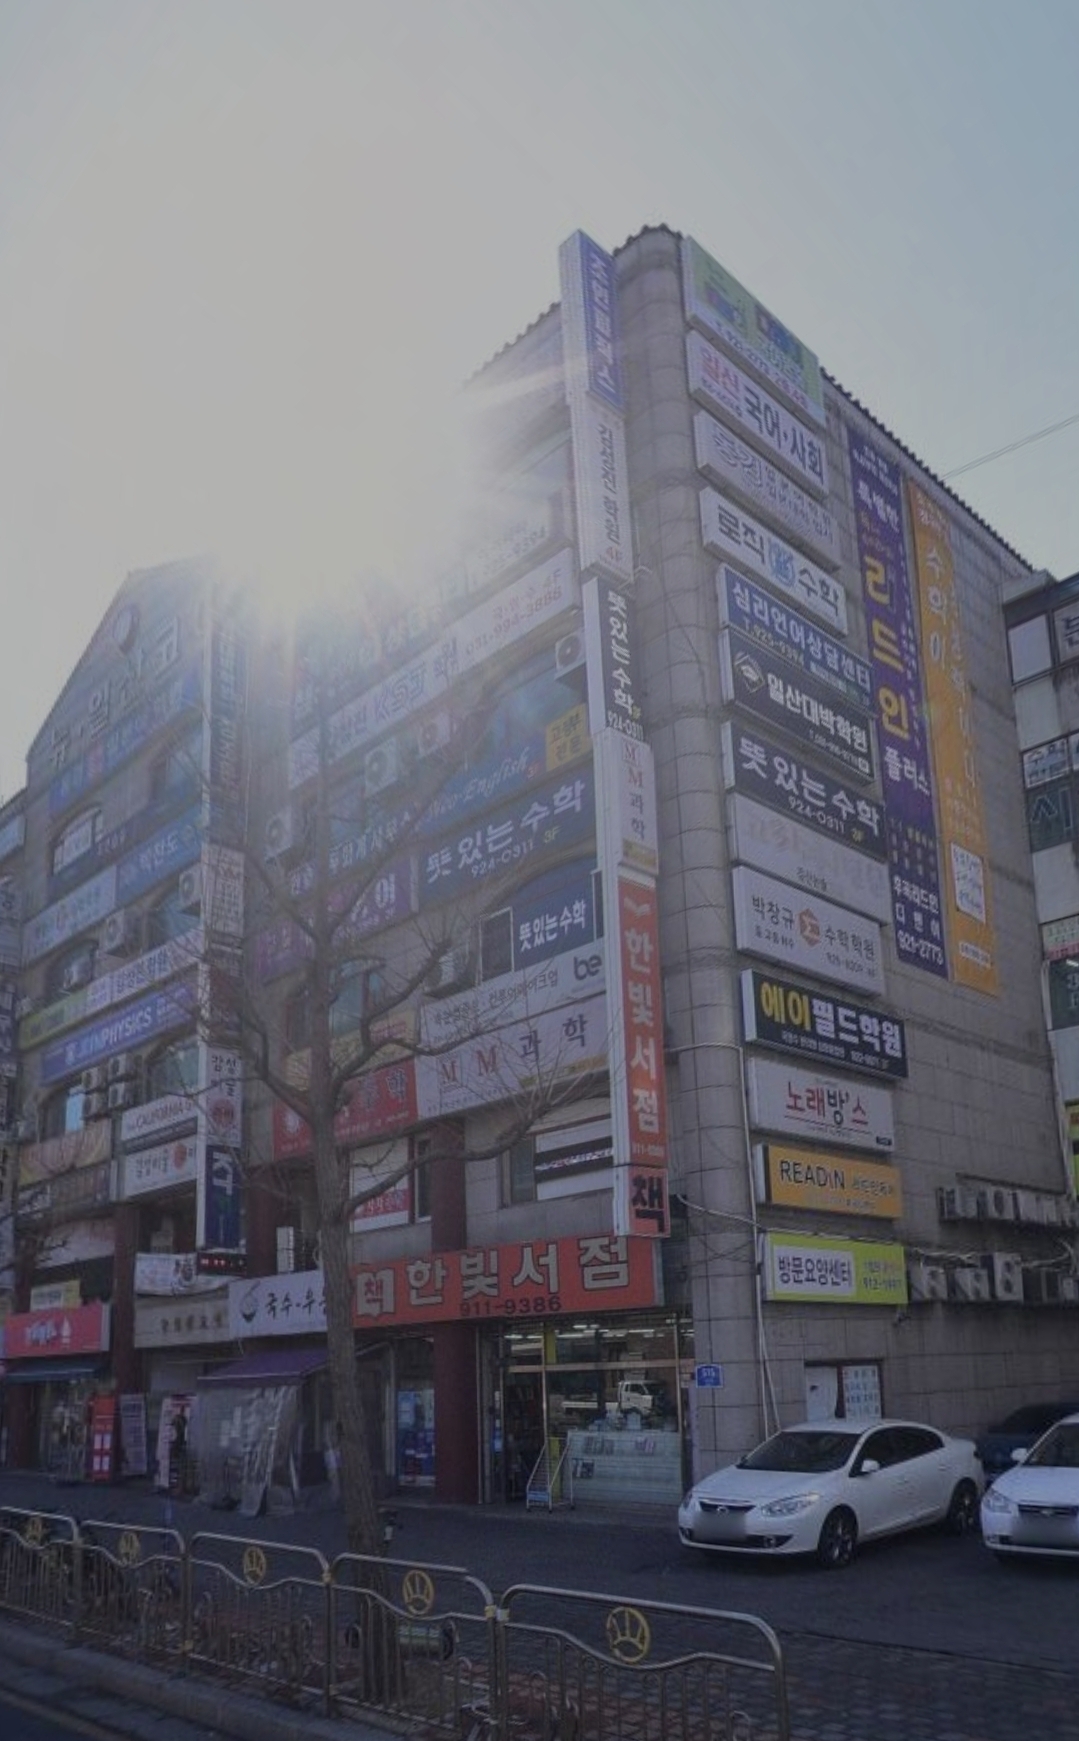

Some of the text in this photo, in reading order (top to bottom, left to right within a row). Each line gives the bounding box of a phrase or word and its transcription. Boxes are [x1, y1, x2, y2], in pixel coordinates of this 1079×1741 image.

[798, 567, 841, 615] 수학
[519, 779, 586, 832] 수학
[833, 786, 881, 835] 수학
[211, 1150, 233, 1197] KT
[407, 1236, 630, 1307] 한빛서점
[778, 1256, 853, 1288] 방문요양센터
[459, 1296, 562, 1318] 911-9386
